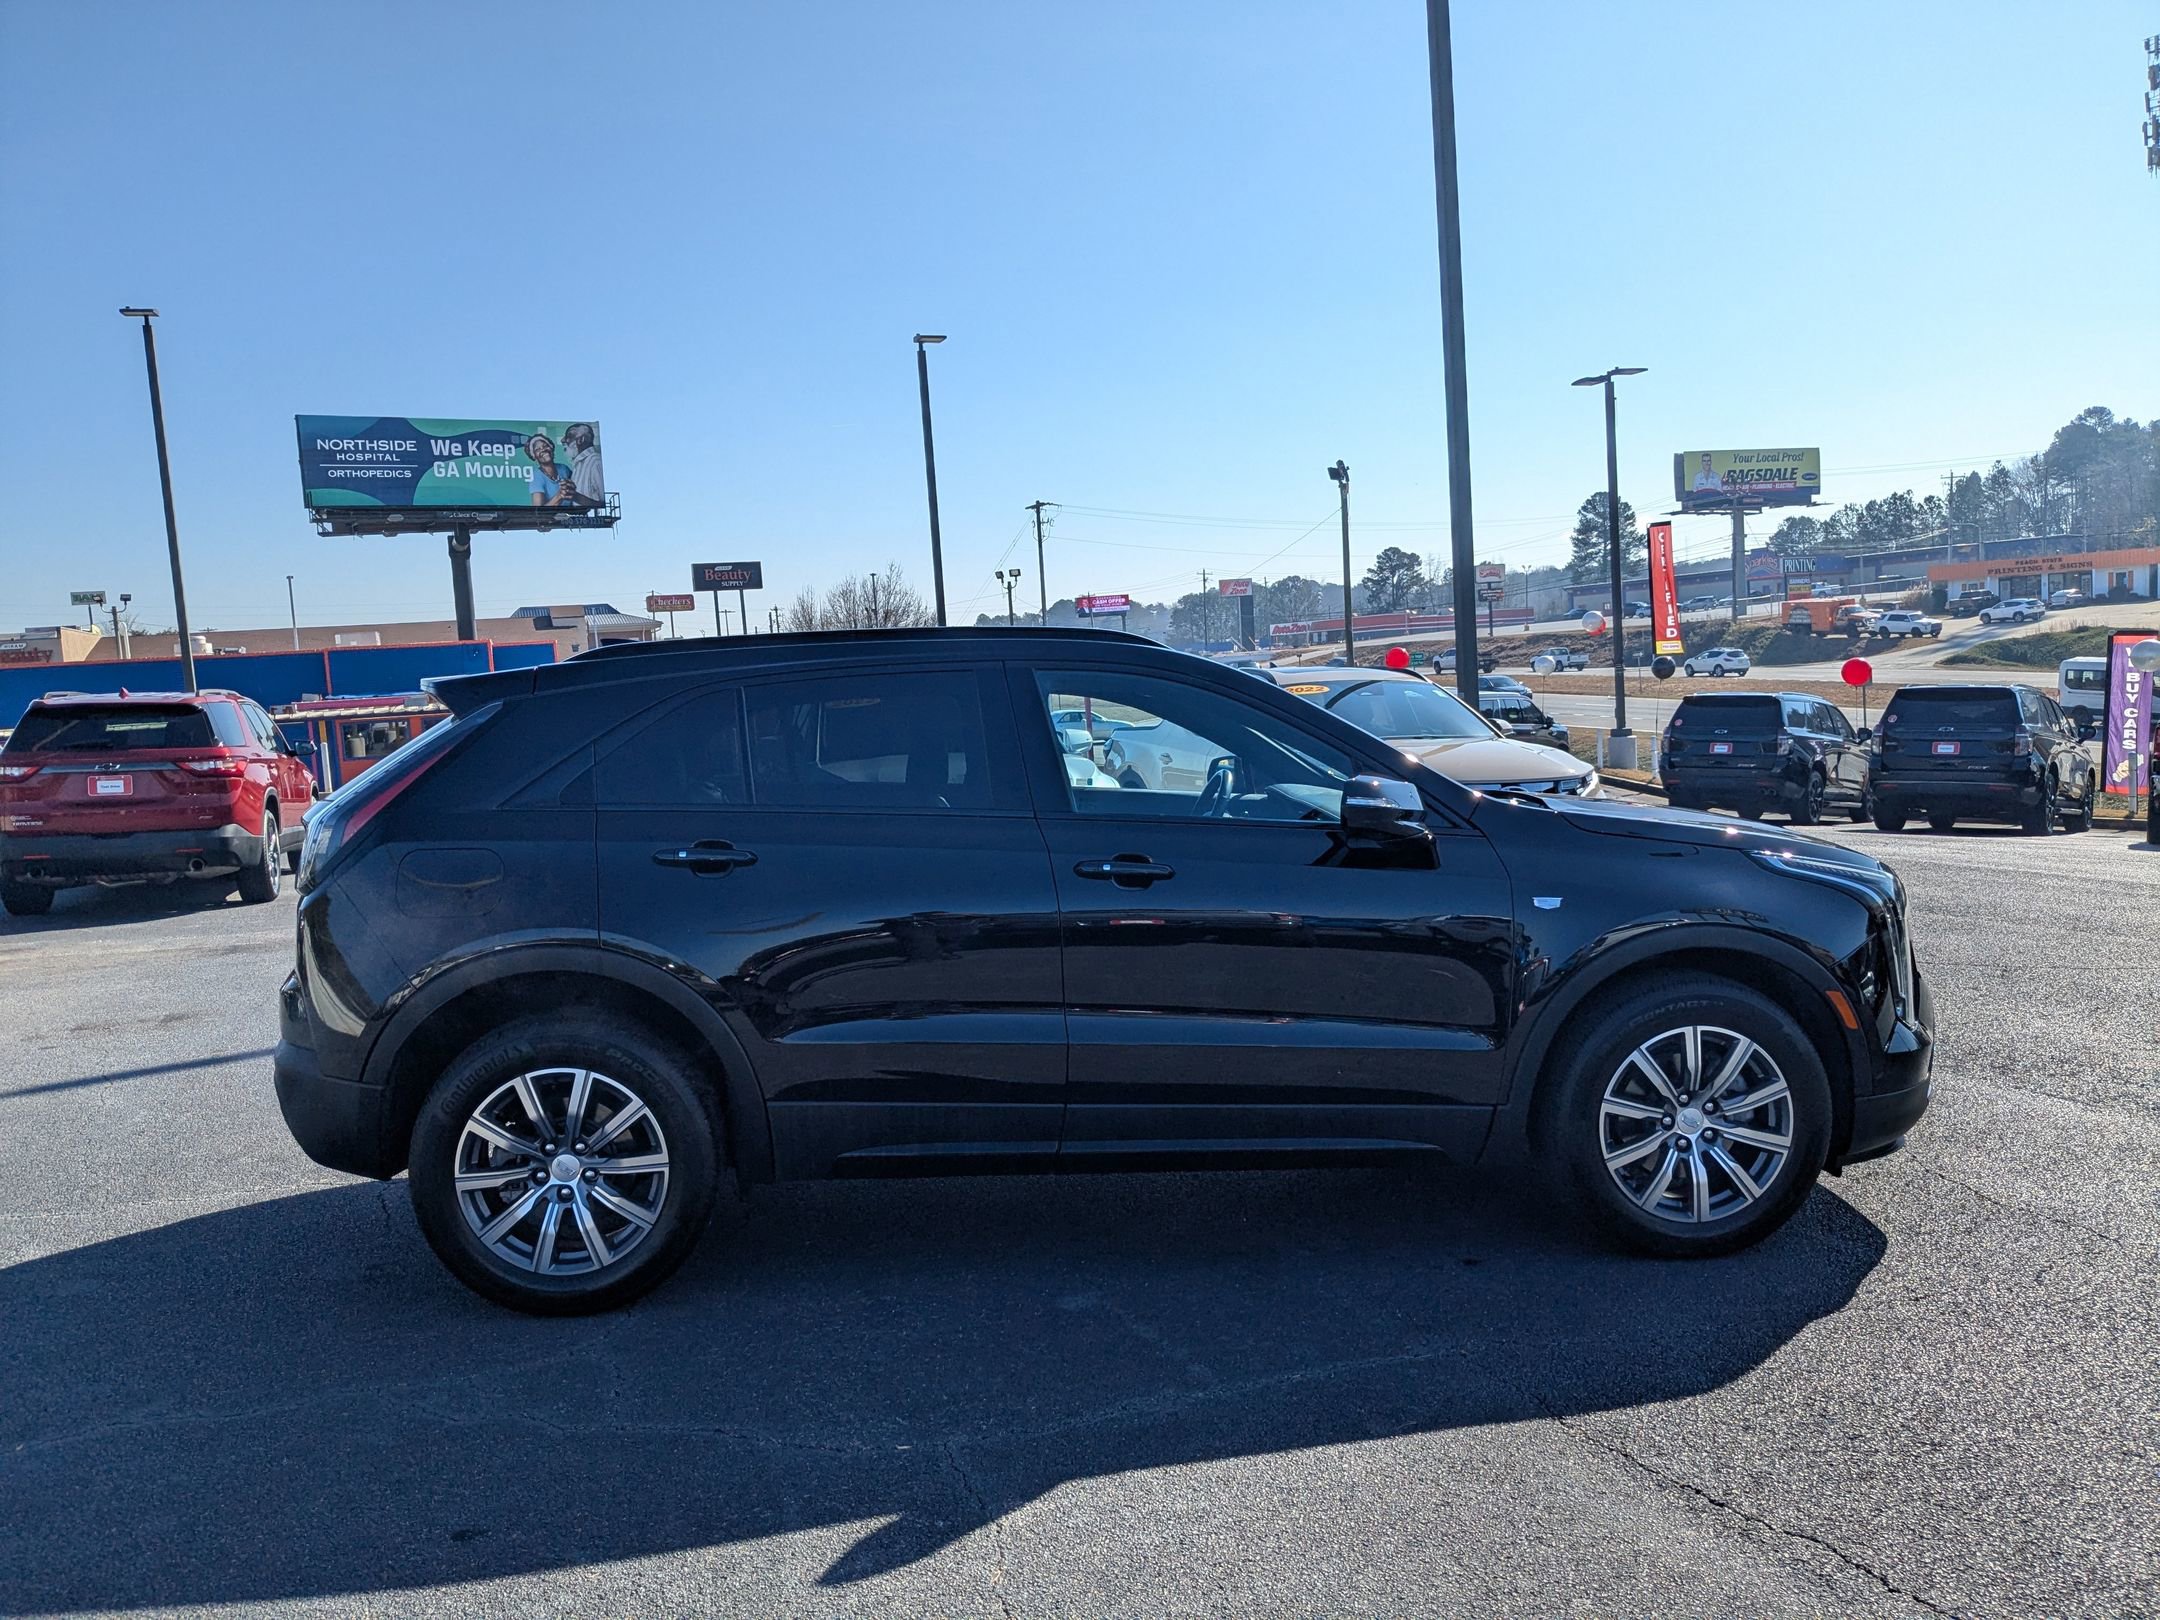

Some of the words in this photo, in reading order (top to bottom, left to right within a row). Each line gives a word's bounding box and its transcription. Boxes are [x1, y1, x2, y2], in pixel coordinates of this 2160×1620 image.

[316, 439, 418, 451] NORTHSIDE
[430, 439, 463, 456] We
[467, 439, 516, 460] Keep
[336, 453, 401, 461] HOSPITAL
[1733, 453, 1755, 464] Your
[1756, 452, 1780, 463] Local
[1782, 451, 1804, 462] Pros!
[327, 469, 412, 478] ORTHOPEDICS
[433, 461, 460, 478] GA
[464, 461, 534, 482] Moving
[1726, 467, 1798, 482] RAGSDALE
[1784, 558, 1816, 573] PRINTING
[1987, 565, 2042, 575] PRINTING
[2060, 561, 2093, 569] SIGNS
[705, 569, 751, 583] Beauty
[1658, 532, 1678, 637] CERIFIED
[1272, 623, 1308, 635] AutoZon
[2126, 672, 2140, 703] BUY
[2122, 708, 2138, 750] CARS
